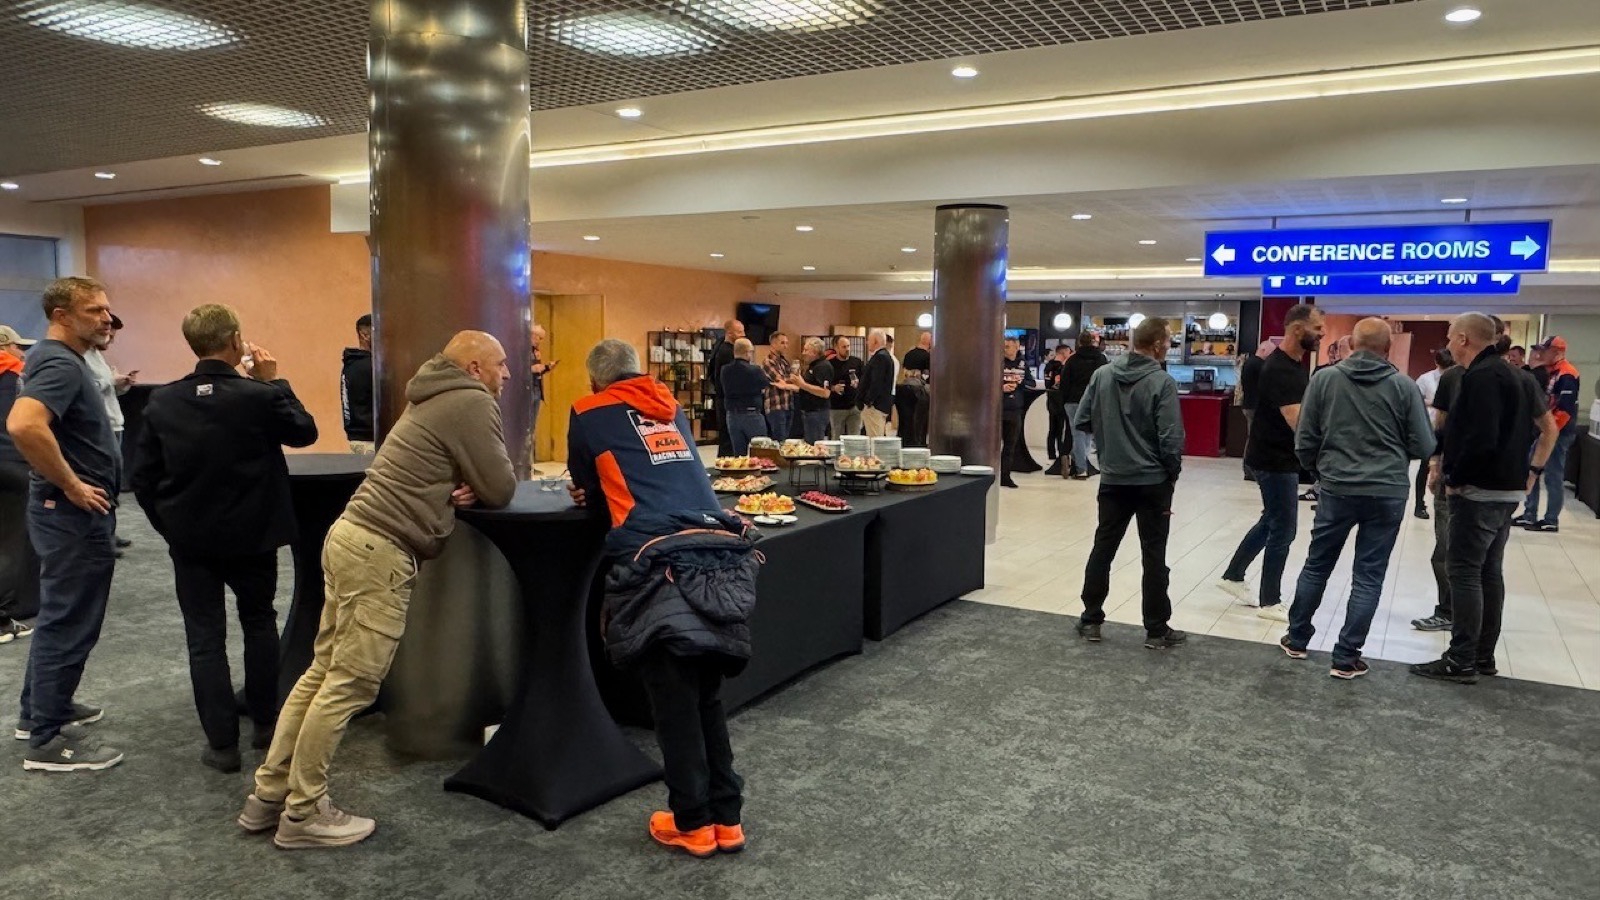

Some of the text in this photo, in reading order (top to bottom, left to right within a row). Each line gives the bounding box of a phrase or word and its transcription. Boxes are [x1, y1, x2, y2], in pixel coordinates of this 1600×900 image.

[1252, 240, 1490, 263] CONFERENCE ROOMS
[1381, 273, 1478, 286] RECEPTION
